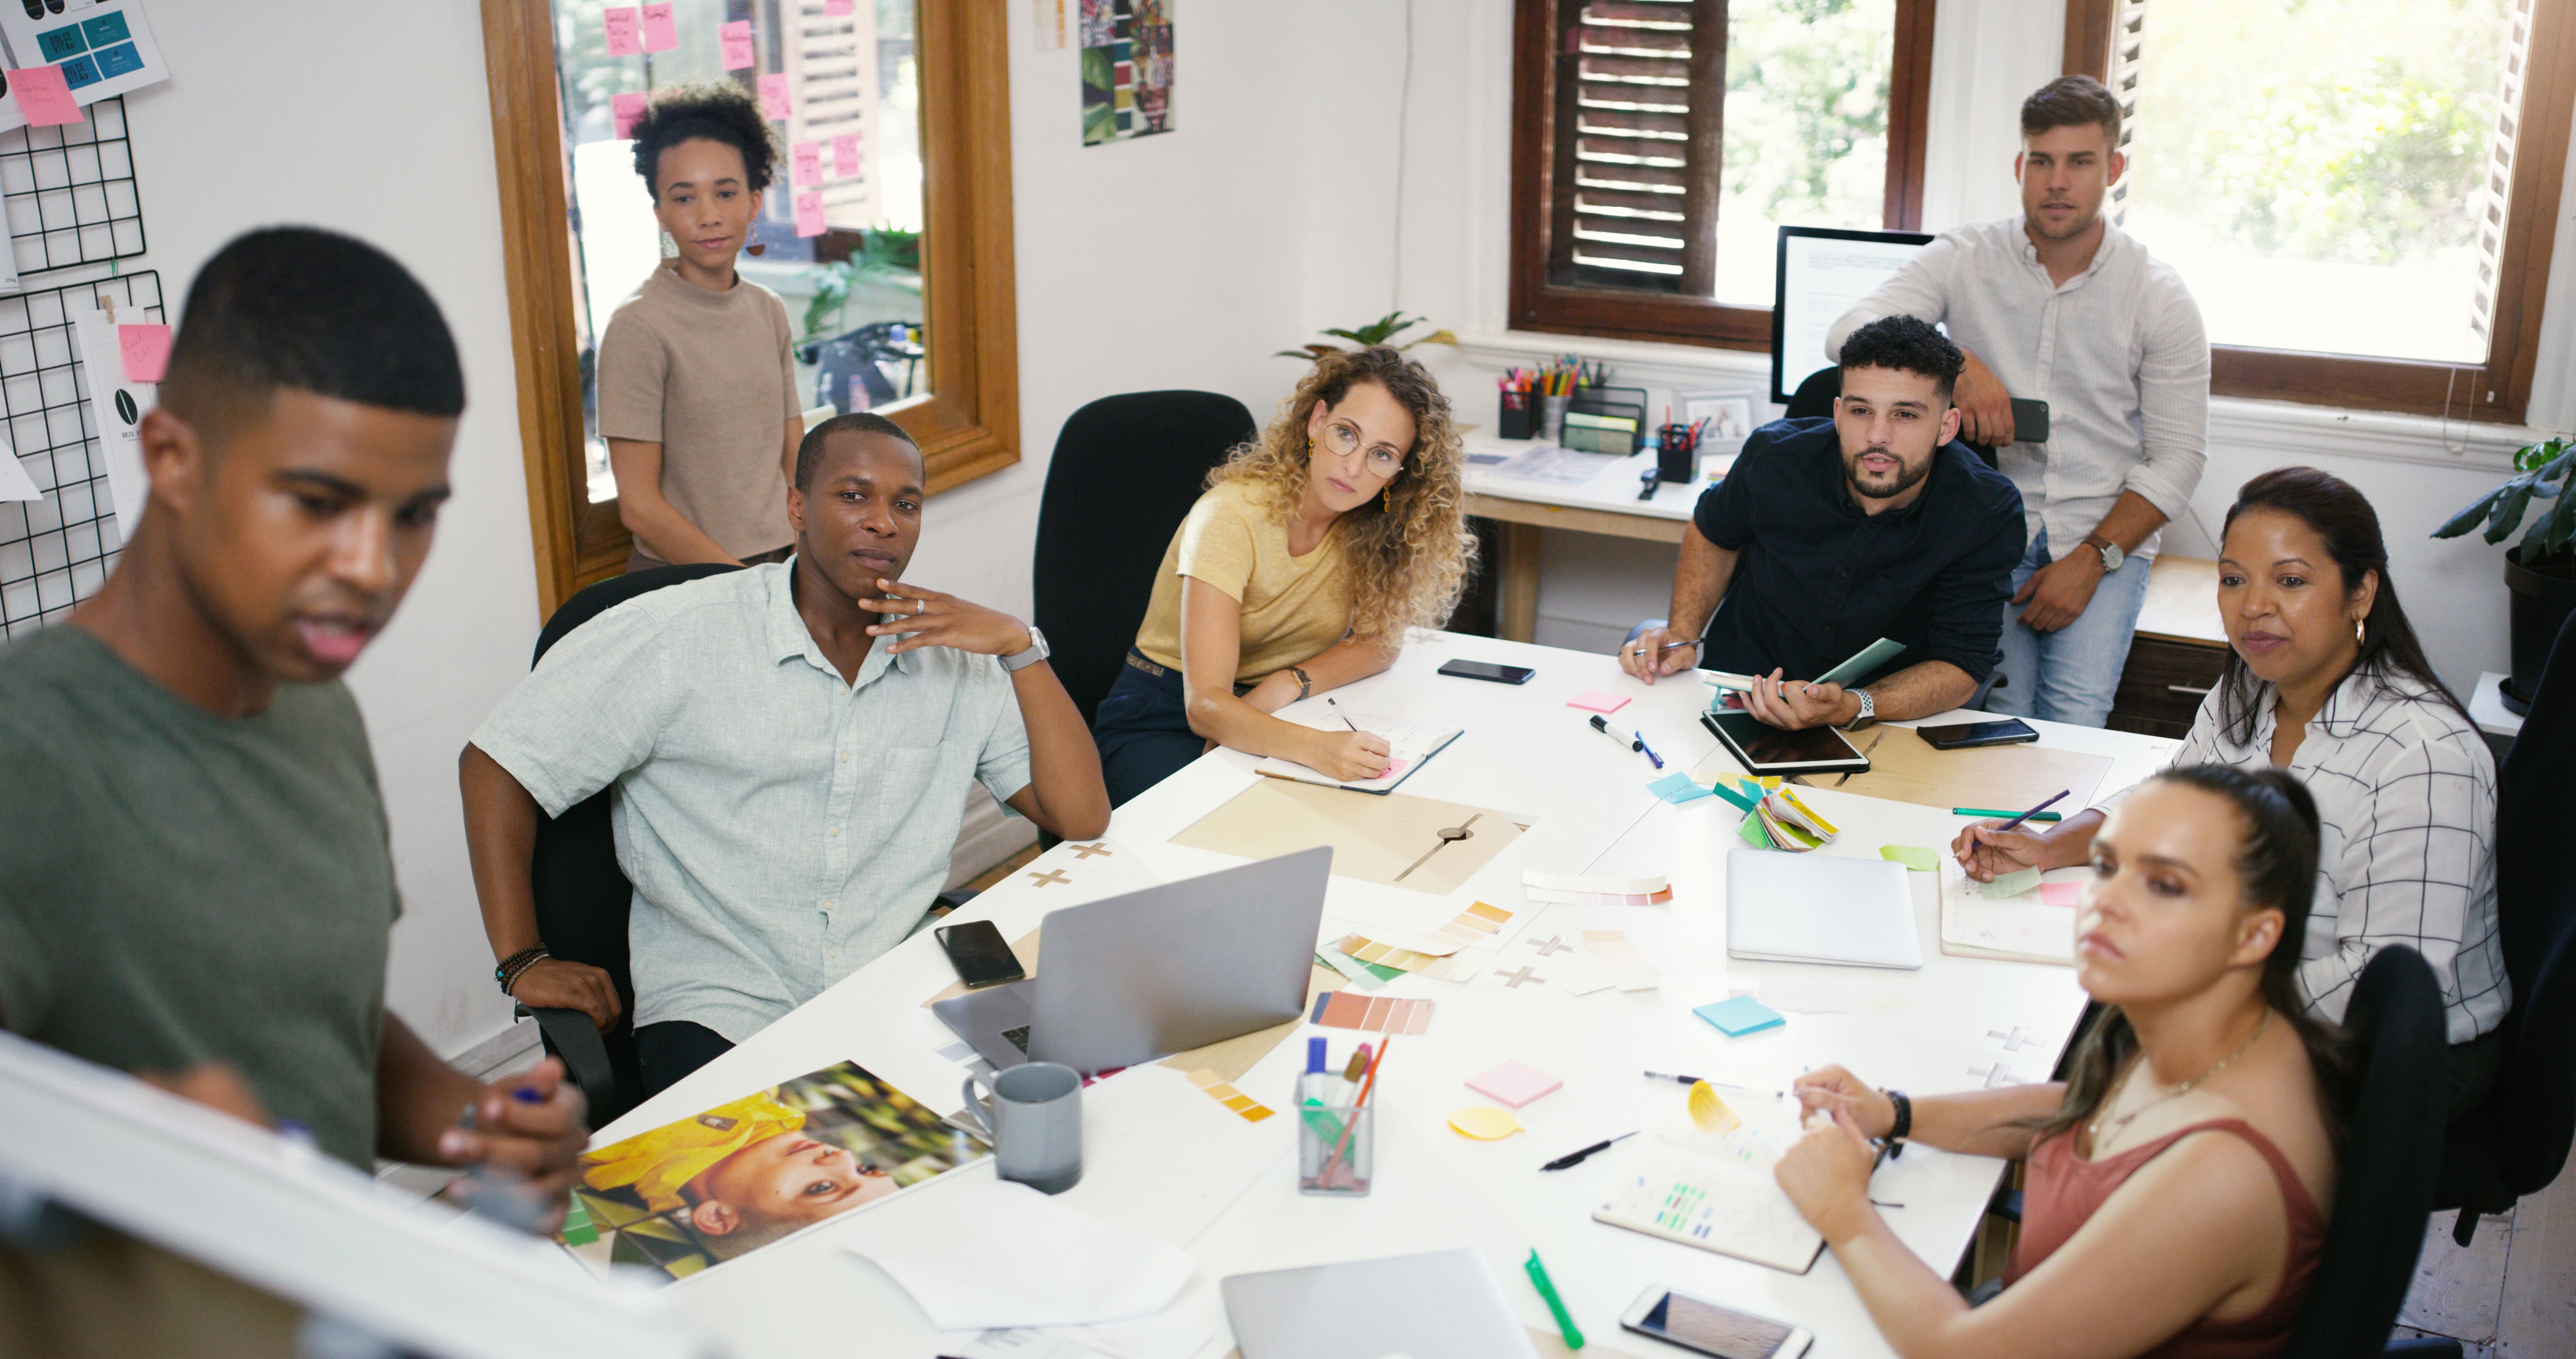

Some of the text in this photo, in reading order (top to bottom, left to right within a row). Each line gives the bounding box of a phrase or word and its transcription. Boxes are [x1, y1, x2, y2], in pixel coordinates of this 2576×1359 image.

[49, 32, 72, 45] DOLCE
[52, 43, 71, 54] VITA
[64, 62, 85, 76] DOLCE
